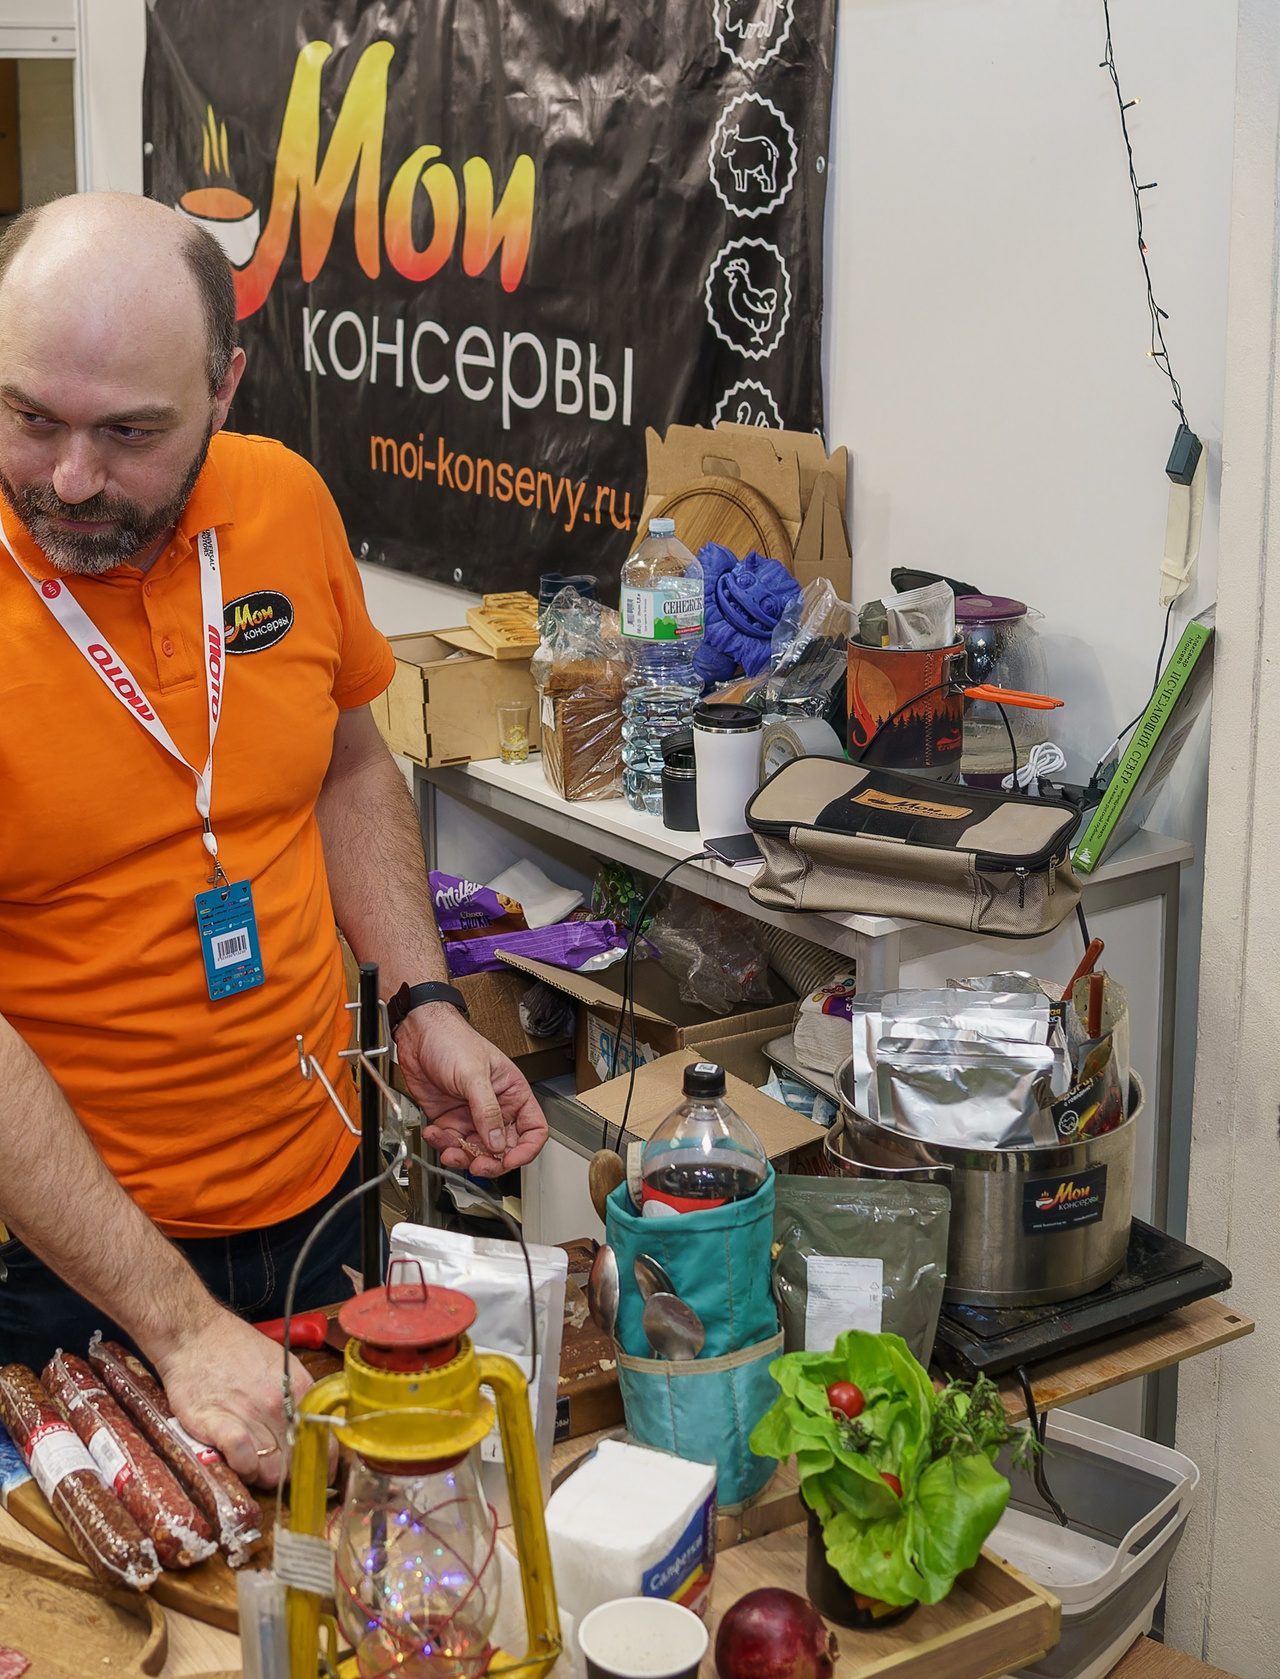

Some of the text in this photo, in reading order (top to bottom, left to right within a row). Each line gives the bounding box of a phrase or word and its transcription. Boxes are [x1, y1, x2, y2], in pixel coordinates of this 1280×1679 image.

[235, 39, 536, 321] Мои
[302, 305, 634, 430] консервы
[370, 432, 631, 533] moi-konservy.ru
[243, 615, 290, 641] консервы
[1176, 636, 1194, 665] Моисеев
[1181, 633, 1202, 668] Александр
[1120, 671, 1182, 784] ИСЧЕЗАЮЩИЙ СЕВЕР
[460, 910, 484, 919] Choco
[460, 915, 494, 931] COOKIE
[1048, 1182, 1091, 1205] Мои
[1058, 1195, 1099, 1211] консервы
